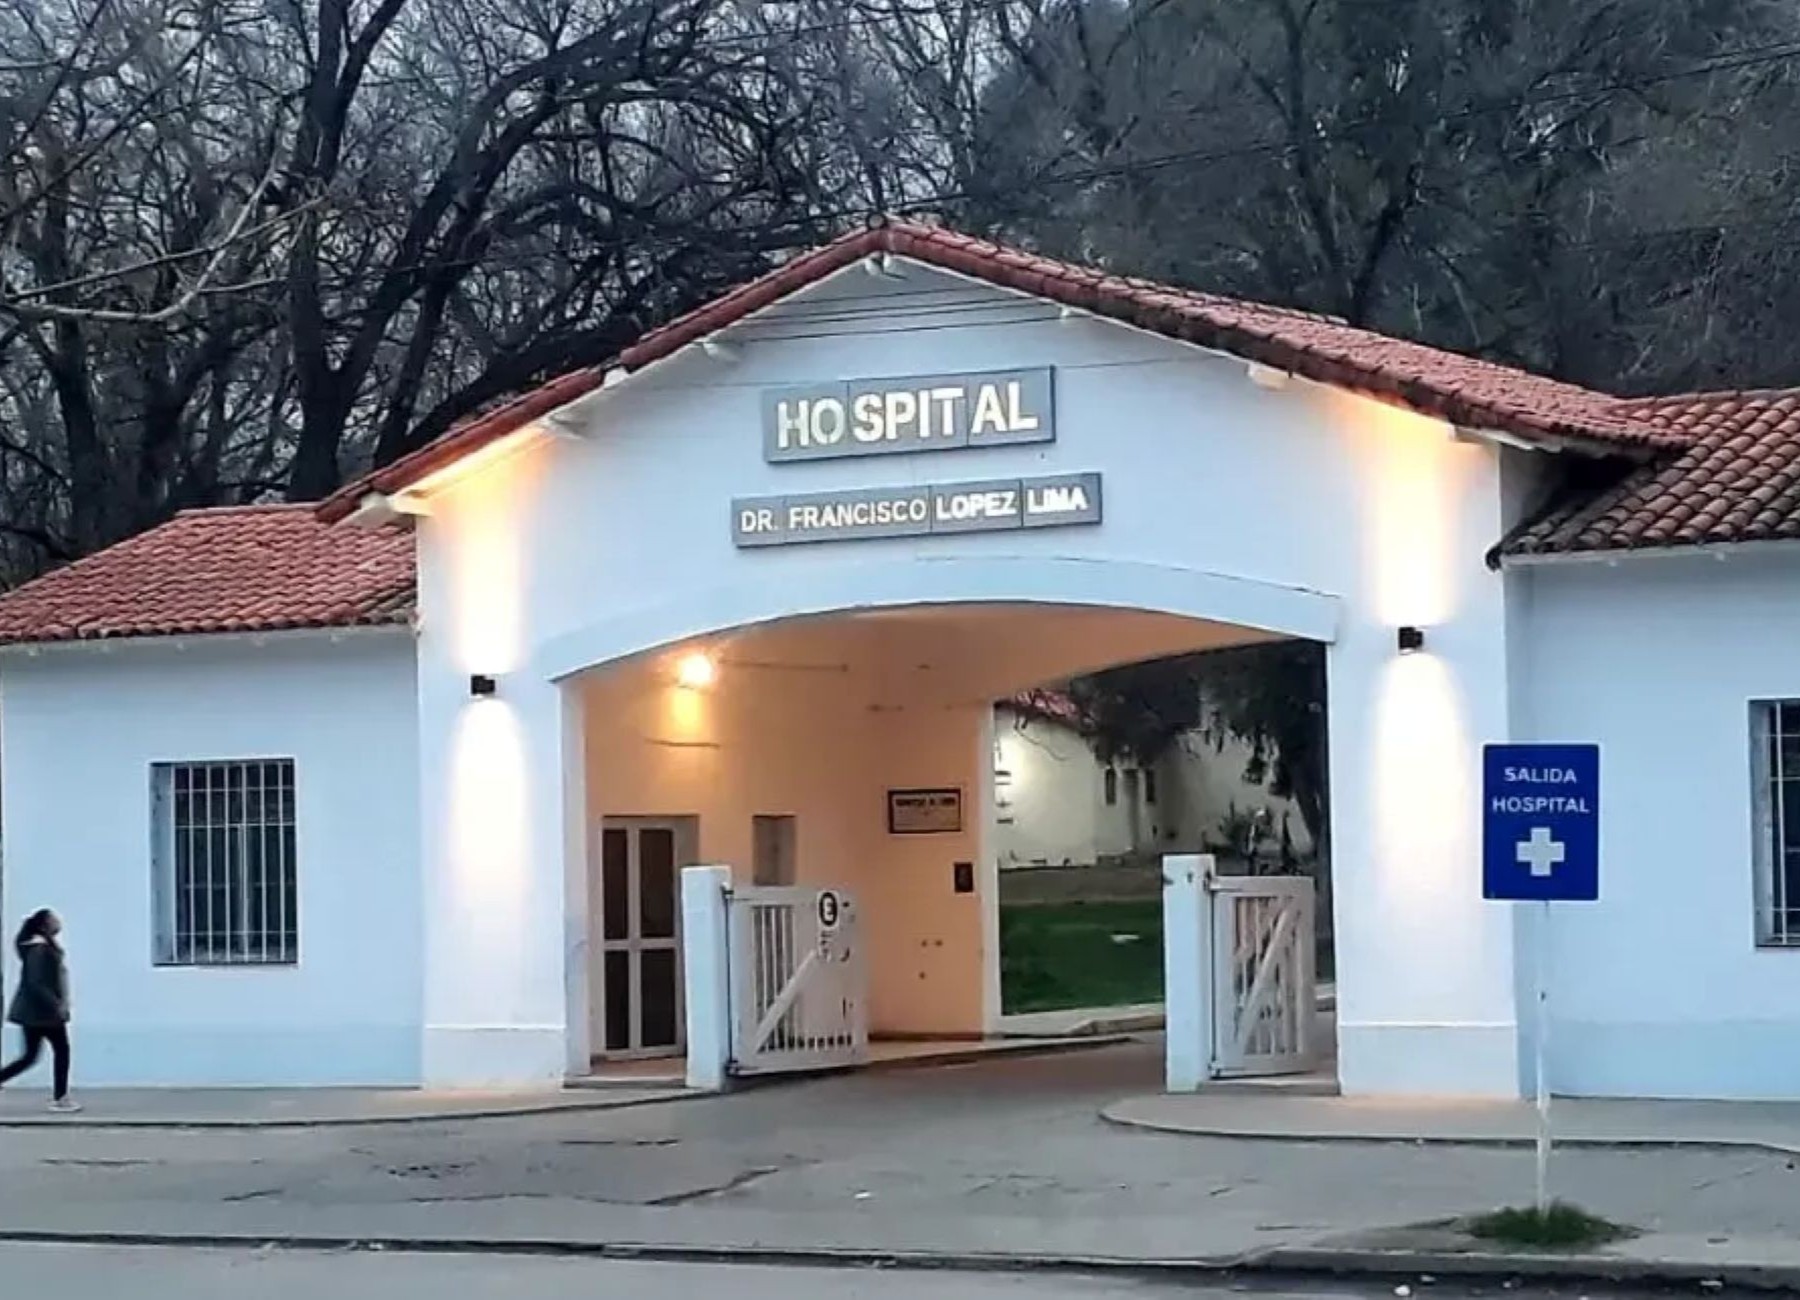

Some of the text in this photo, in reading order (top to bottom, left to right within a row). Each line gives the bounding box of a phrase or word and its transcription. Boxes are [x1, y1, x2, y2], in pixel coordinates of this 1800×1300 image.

[777, 381, 1039, 448] HOSPITAL
[740, 486, 1087, 532] DR. FRANCISCO LOPEZ LIMA
[1504, 766, 1577, 783] SALIDA
[1492, 797, 1590, 813] HOSPITAL
